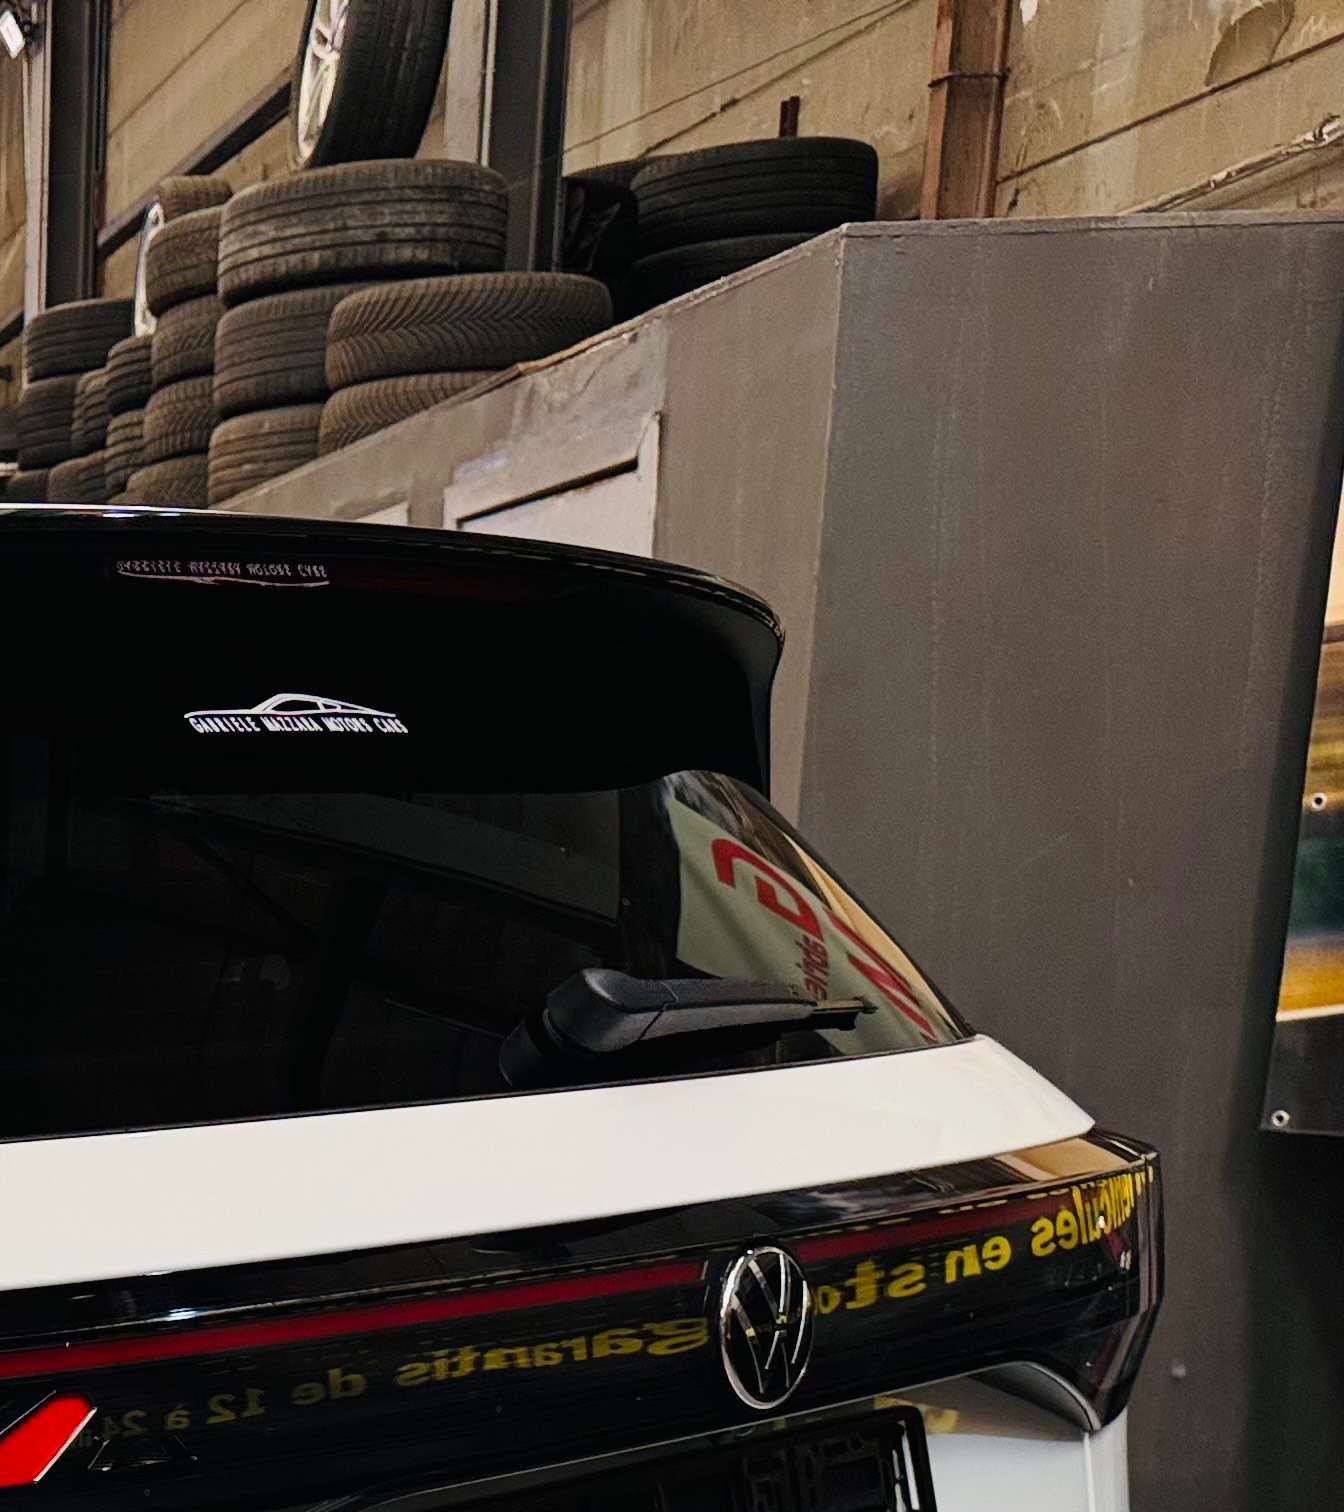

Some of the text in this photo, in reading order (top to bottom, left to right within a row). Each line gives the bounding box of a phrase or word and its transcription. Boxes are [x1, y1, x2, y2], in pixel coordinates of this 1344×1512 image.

[188, 717, 261, 733] GABRIELE
[322, 717, 373, 733] MOTORS
[373, 719, 408, 733] CARS
